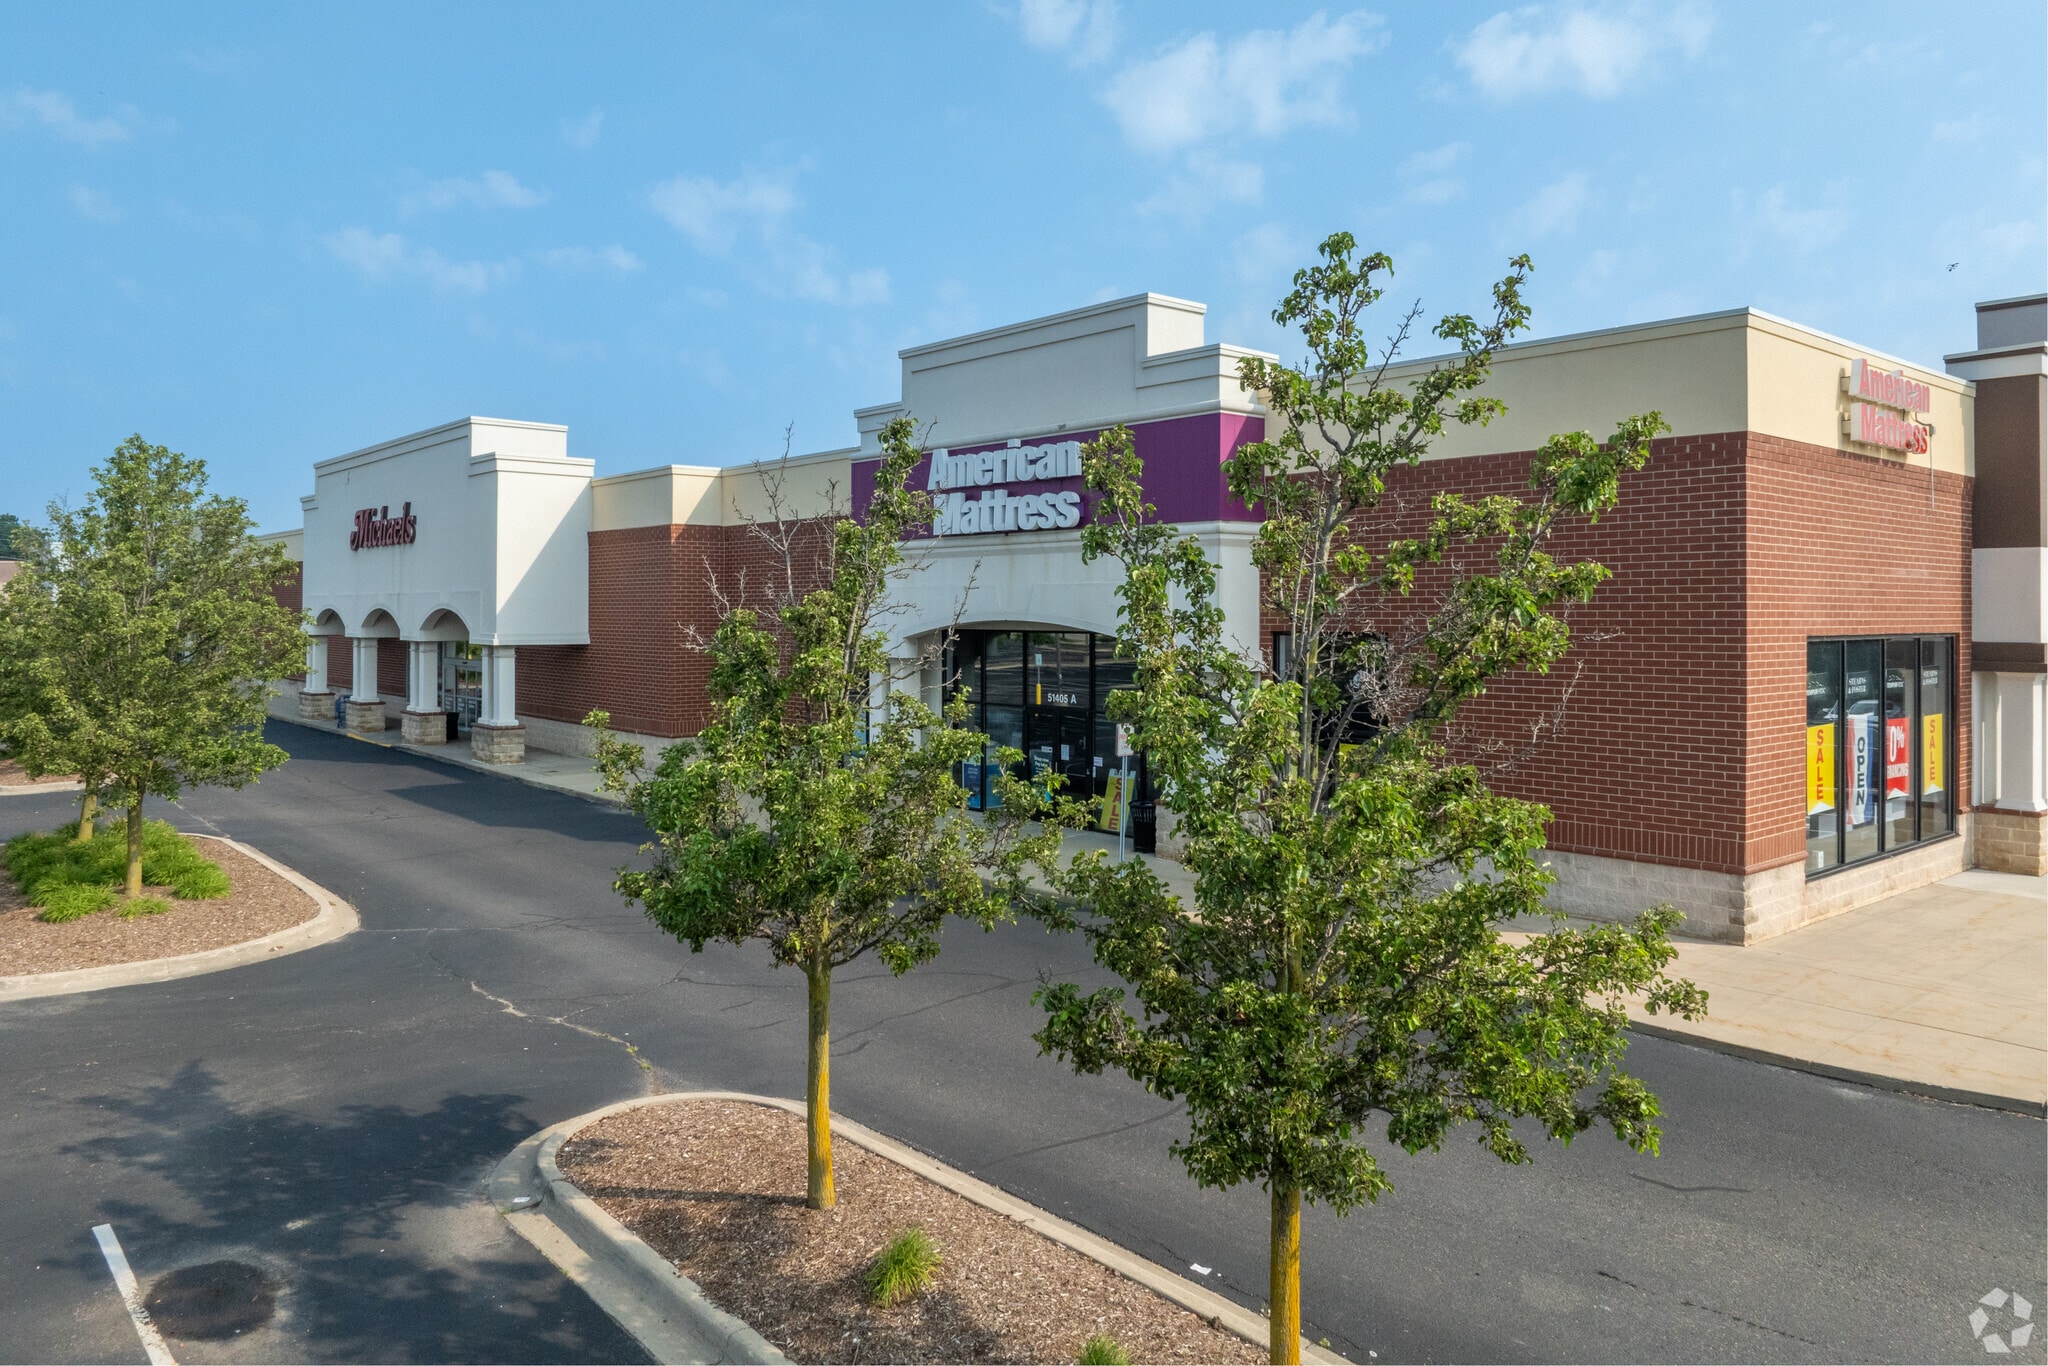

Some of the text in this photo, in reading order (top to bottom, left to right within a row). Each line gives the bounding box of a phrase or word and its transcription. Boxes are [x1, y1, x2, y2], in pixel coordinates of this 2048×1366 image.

[1855, 358, 1930, 413] American
[1857, 402, 1928, 454] Mattress
[927, 438, 1083, 491] American
[350, 502, 417, 551] Michaels
[933, 489, 1081, 536] Mattress
[1047, 693, 1077, 704] 51405 A
[1816, 729, 1824, 800] SALE
[1889, 725, 1904, 763] 0%
[1856, 737, 1866, 806] OPEN
[1108, 778, 1122, 831] SALE
